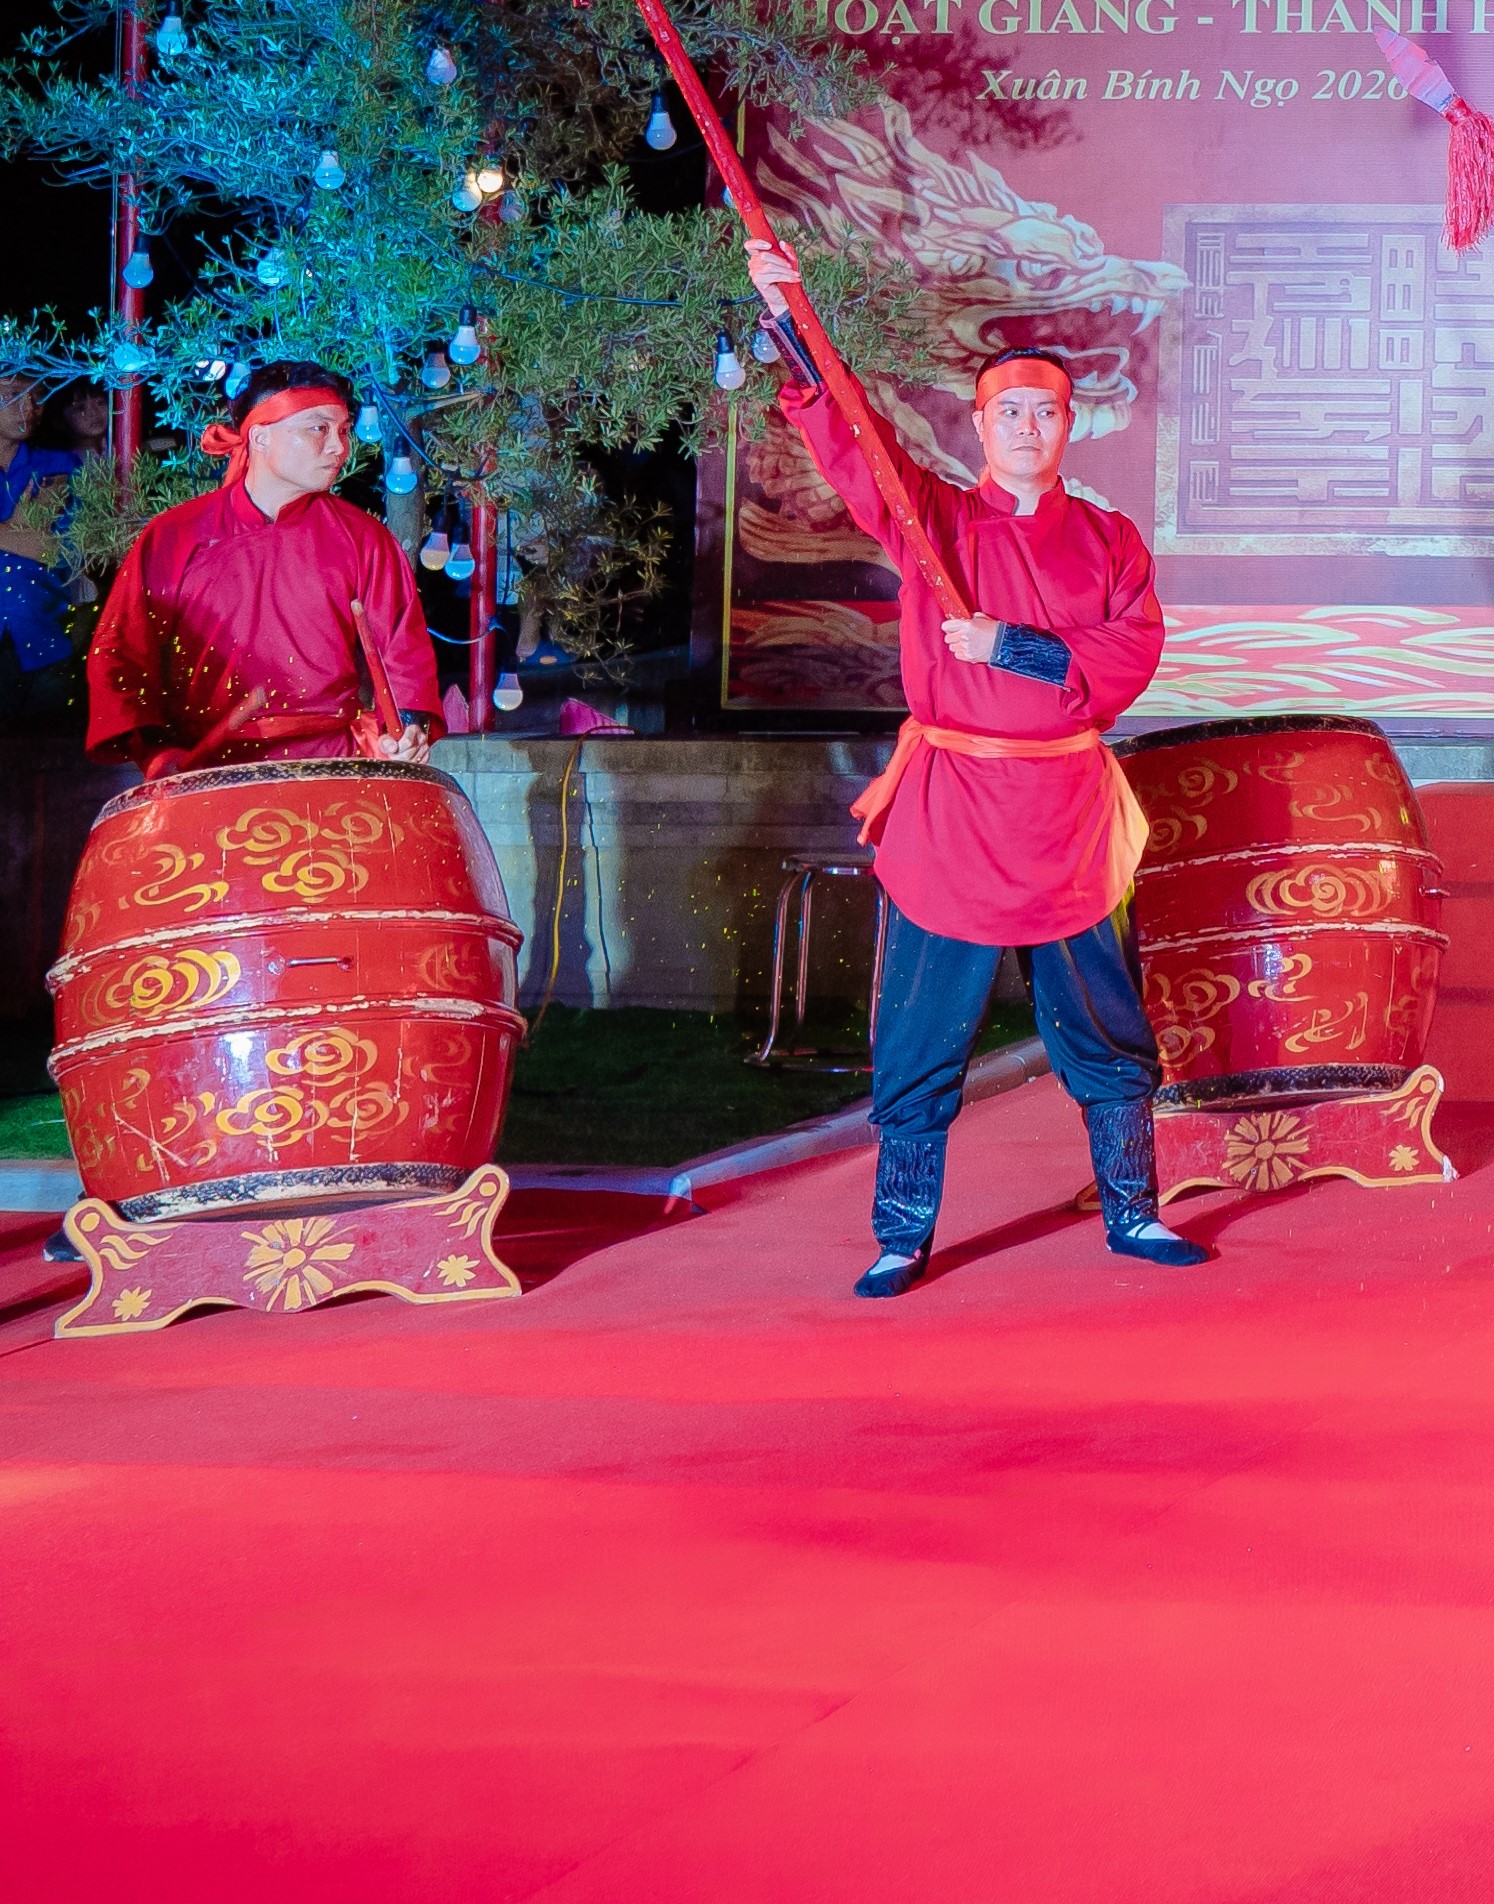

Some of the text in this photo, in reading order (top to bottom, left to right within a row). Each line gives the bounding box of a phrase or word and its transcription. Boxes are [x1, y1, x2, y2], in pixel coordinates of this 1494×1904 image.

[976, 68, 1089, 101] Xuân
[1102, 69, 1201, 100] Bính
[1215, 69, 1300, 108] Ngọ
